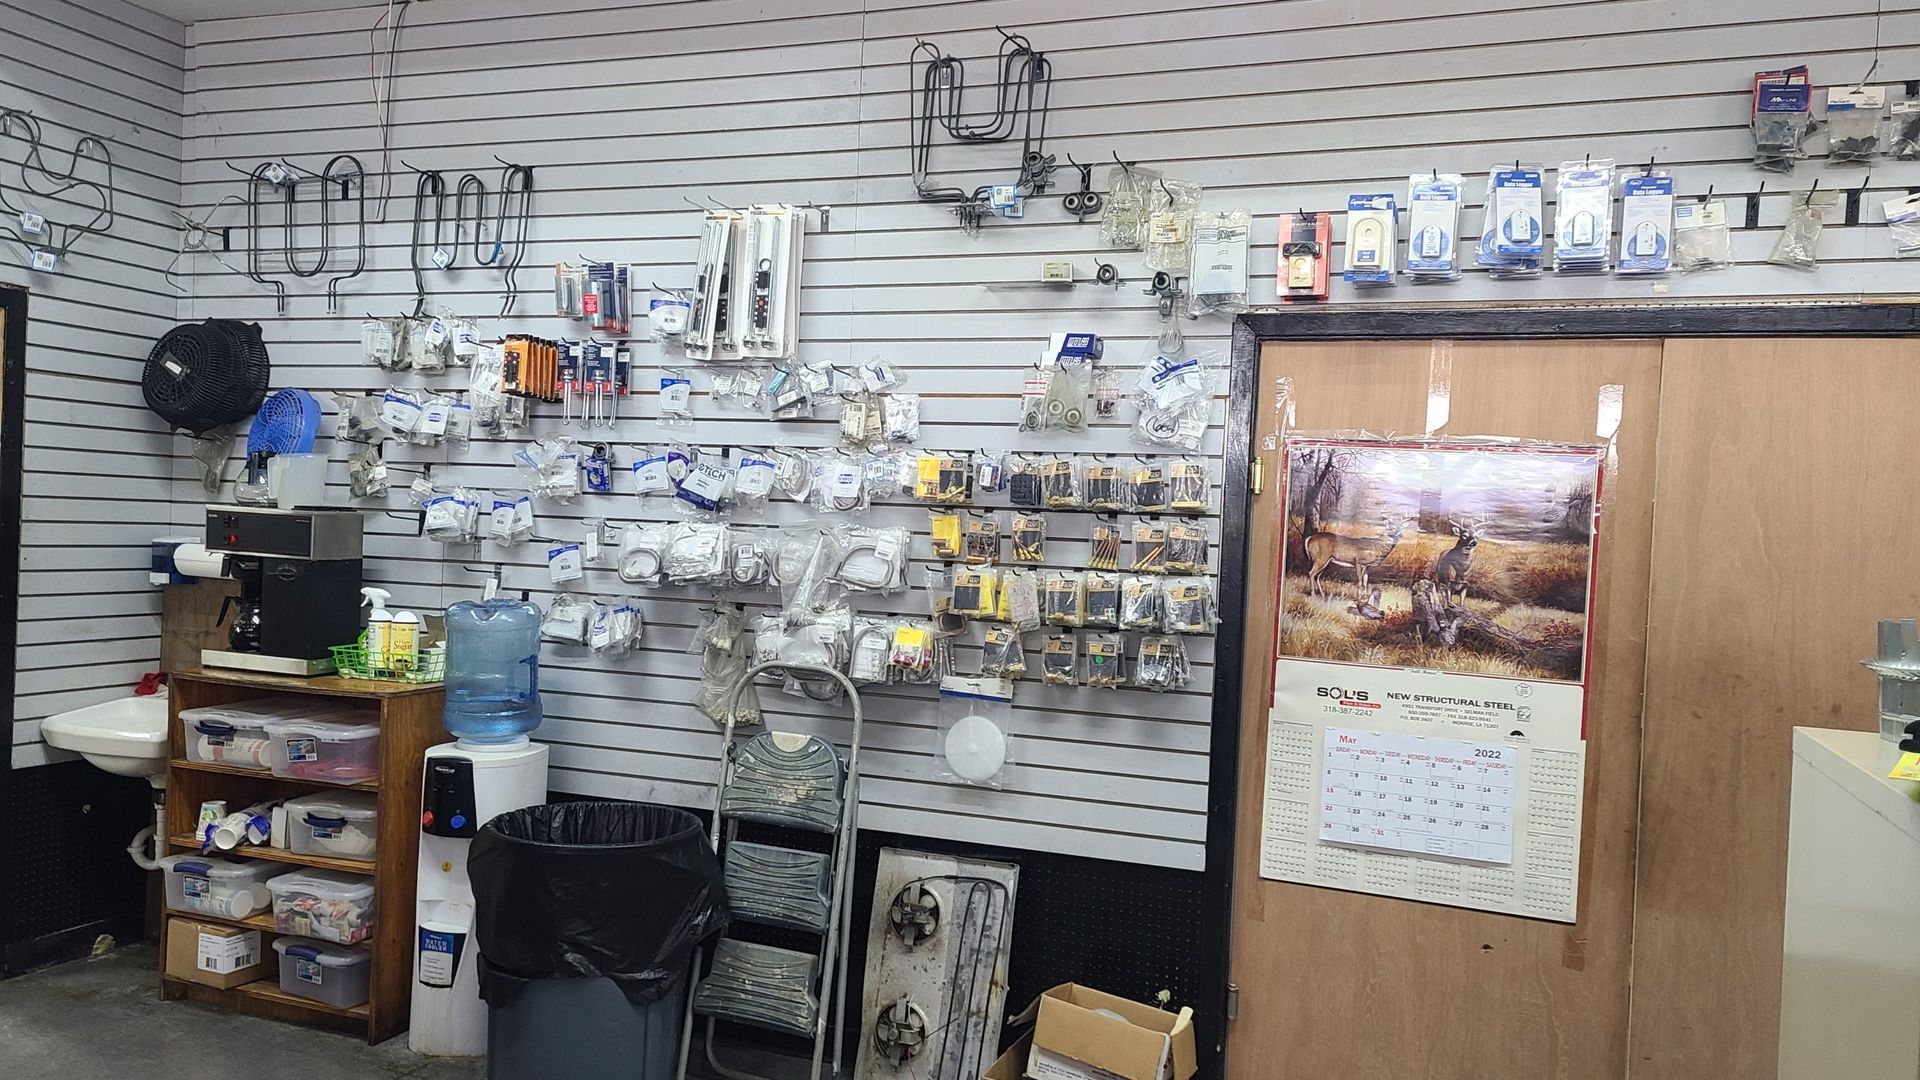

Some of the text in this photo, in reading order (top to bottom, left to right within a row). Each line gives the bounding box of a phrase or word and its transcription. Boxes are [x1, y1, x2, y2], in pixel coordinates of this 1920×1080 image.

[394, 640, 412, 651] Sugar
[1317, 686, 1369, 701] SOL'S
[1387, 692, 1516, 710] NEW STRUCTURAL STEEL
[1323, 706, 1373, 717] 318-387-2242
[1474, 749, 1502, 759] 2022
